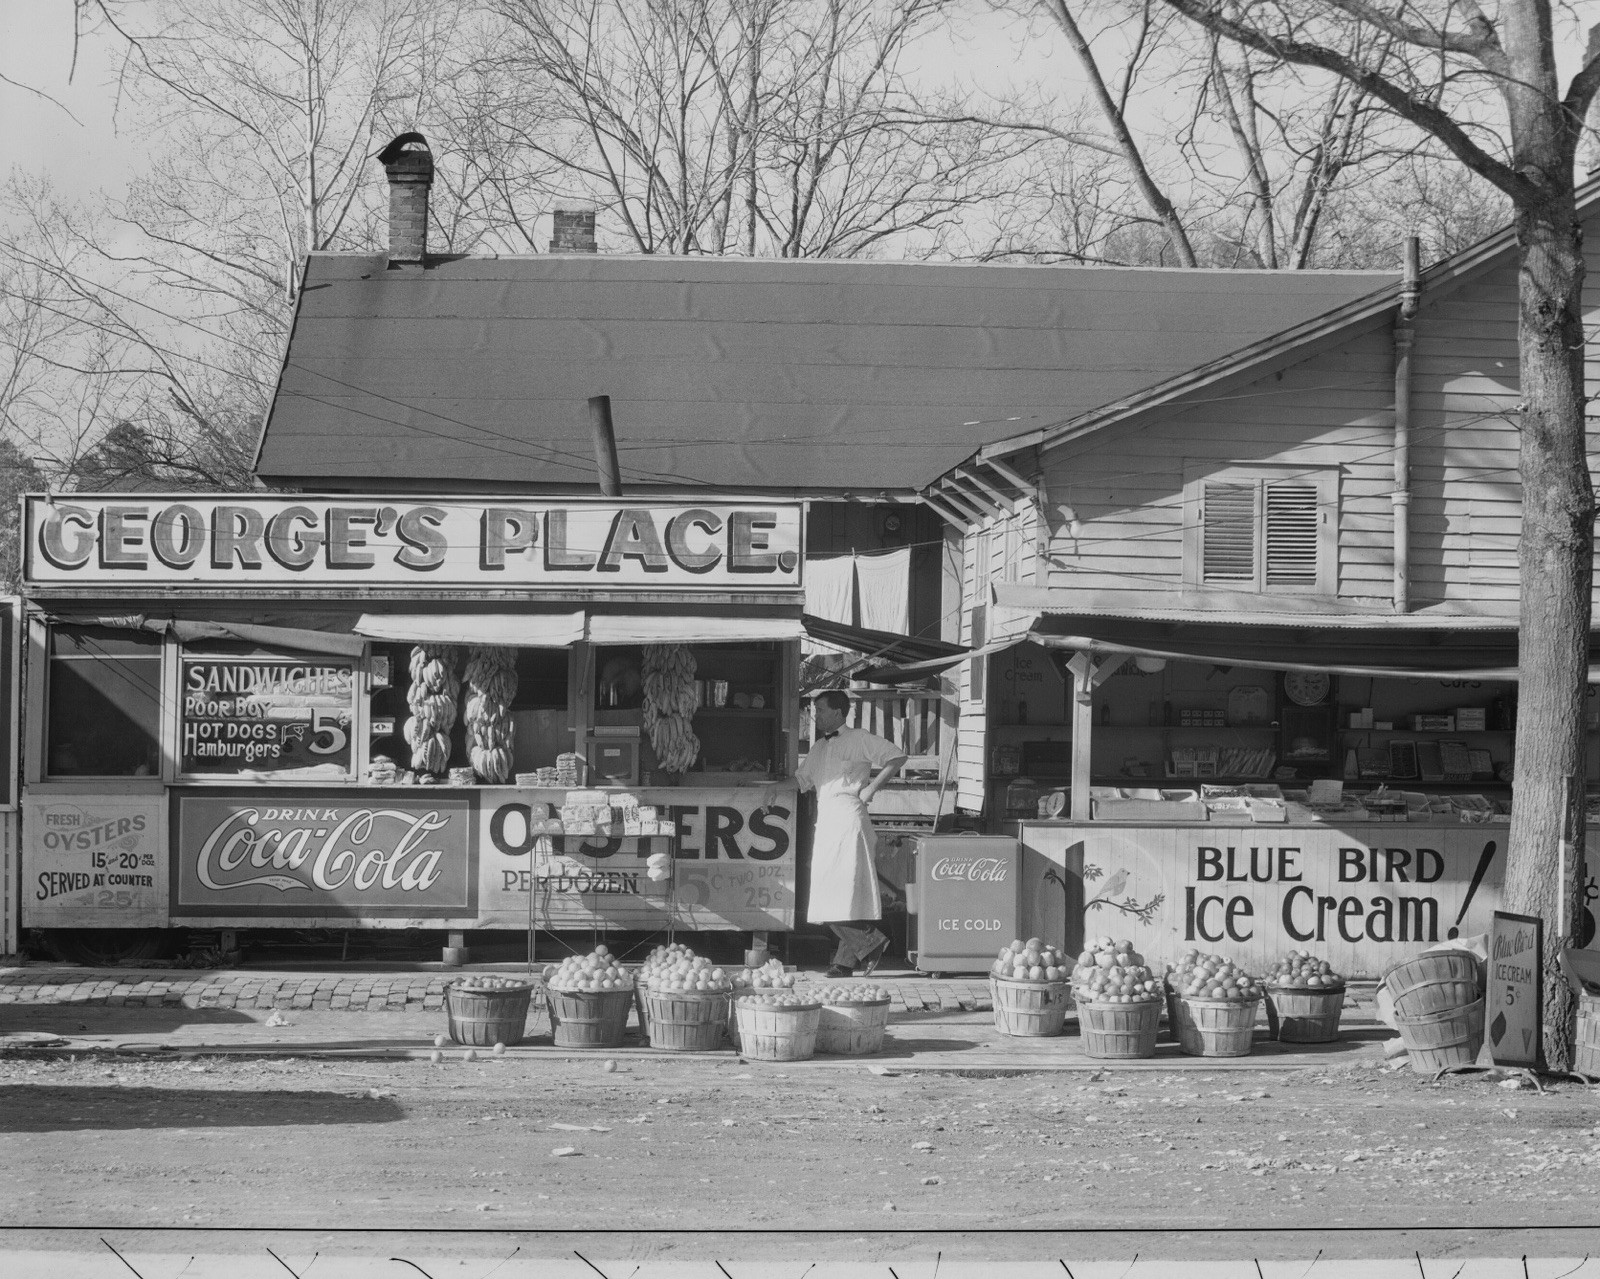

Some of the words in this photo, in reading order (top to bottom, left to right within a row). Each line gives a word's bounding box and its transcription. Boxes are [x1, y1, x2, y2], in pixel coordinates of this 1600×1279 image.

[38, 504, 448, 572] GEORGE'S
[479, 508, 799, 574] PLACE.
[187, 665, 352, 694] SANDWICHES
[227, 724, 277, 740] DOGS
[184, 737, 281, 762] Hamburgers
[46, 813, 81, 826] FRESH
[262, 808, 340, 822] DRINK
[43, 814, 146, 851] OYSTERS
[197, 808, 452, 892] Coca-Cola
[931, 857, 1009, 882] Coca-Cola
[1197, 847, 1302, 883] BLUE
[1338, 848, 1445, 883] BIRD
[36, 871, 90, 900] SERVED
[93, 874, 105, 887] AT
[108, 874, 153, 888] COUNTER
[555, 872, 640, 894] DOZEN
[938, 919, 960, 931] ICE
[964, 919, 1002, 931] COLD
[1185, 886, 1254, 942] Ice
[1495, 963, 1506, 981] ICE
[1507, 965, 1532, 985] CREAM
